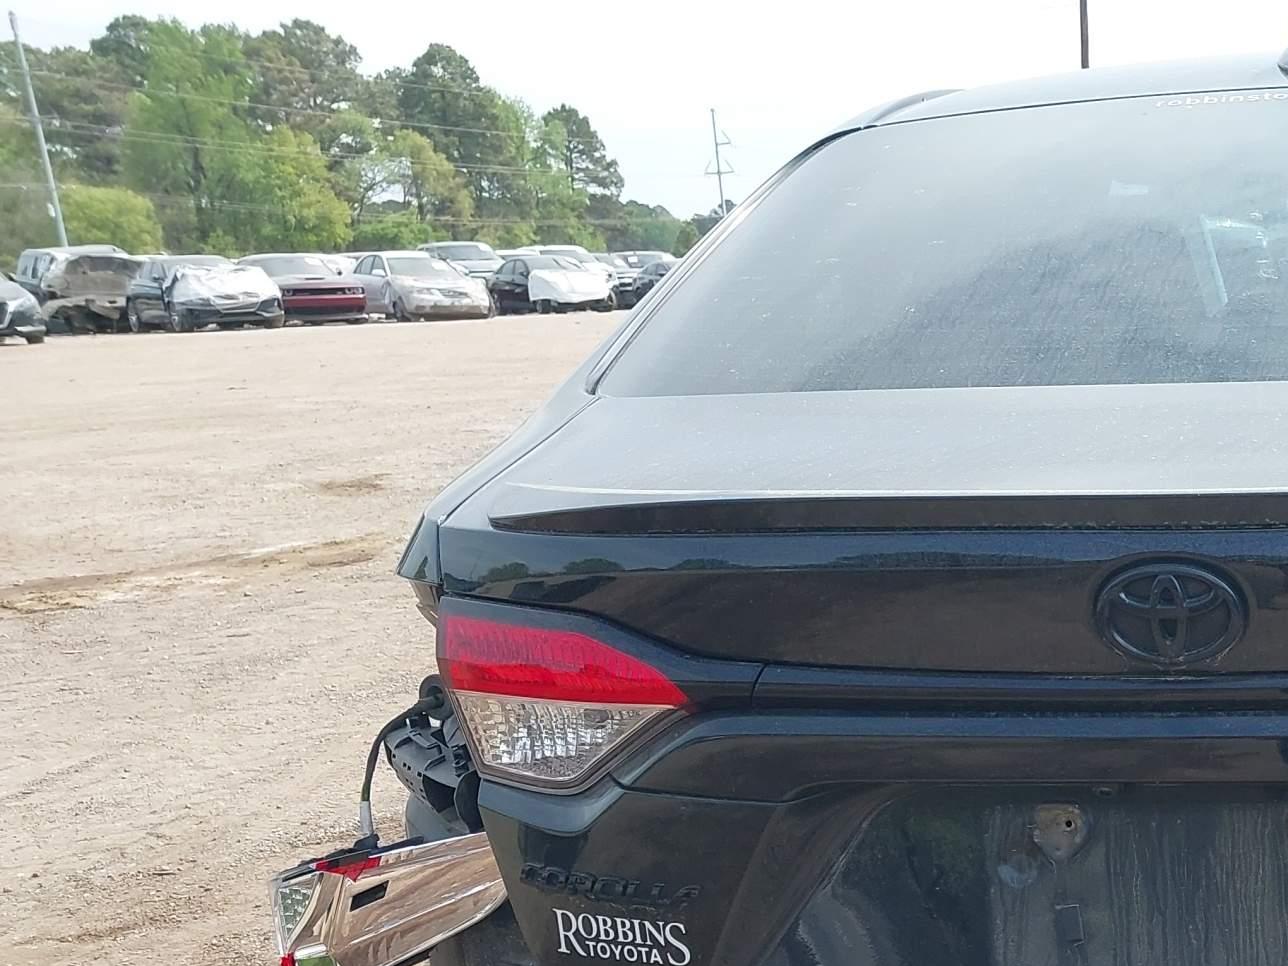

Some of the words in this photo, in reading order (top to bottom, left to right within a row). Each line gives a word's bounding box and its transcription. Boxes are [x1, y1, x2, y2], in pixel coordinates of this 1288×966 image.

[520, 862, 701, 903] COROLLA
[552, 907, 691, 966] ROBBINS
[585, 940, 663, 965] TOYOTA
